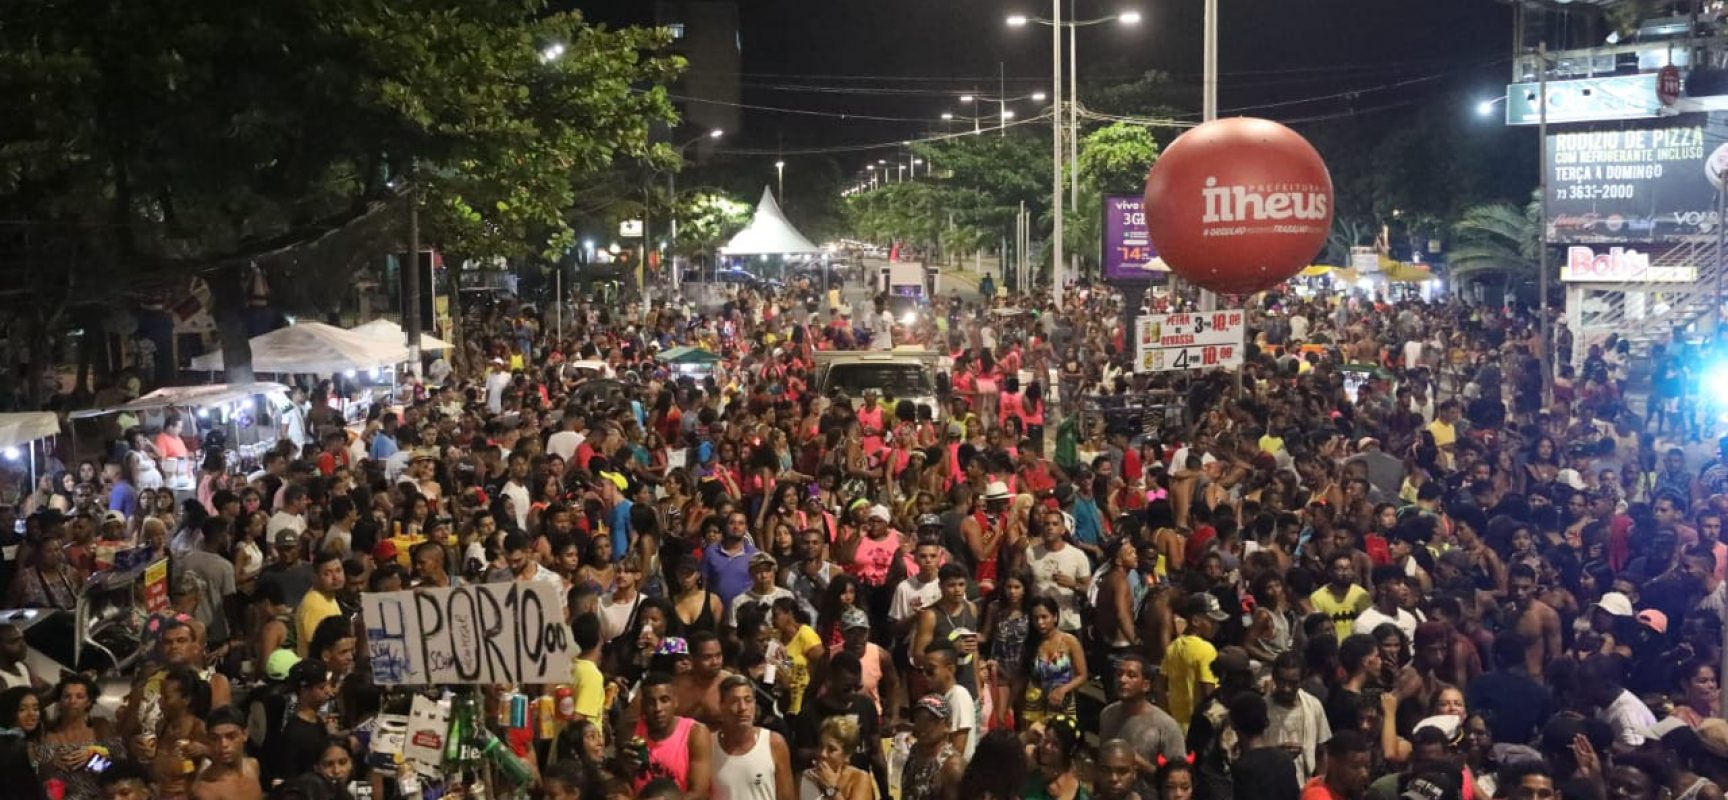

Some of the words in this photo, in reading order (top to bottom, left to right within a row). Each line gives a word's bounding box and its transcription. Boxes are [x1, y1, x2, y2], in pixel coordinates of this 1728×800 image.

[1624, 130, 1645, 148] DE
[1652, 126, 1703, 148] PIZZA
[1657, 147, 1703, 160] INCLUSO
[1555, 166, 1590, 184] TERÇA
[1606, 164, 1662, 179] DOMINGO
[1194, 316, 1204, 333] 3
[1173, 349, 1190, 371] 4
